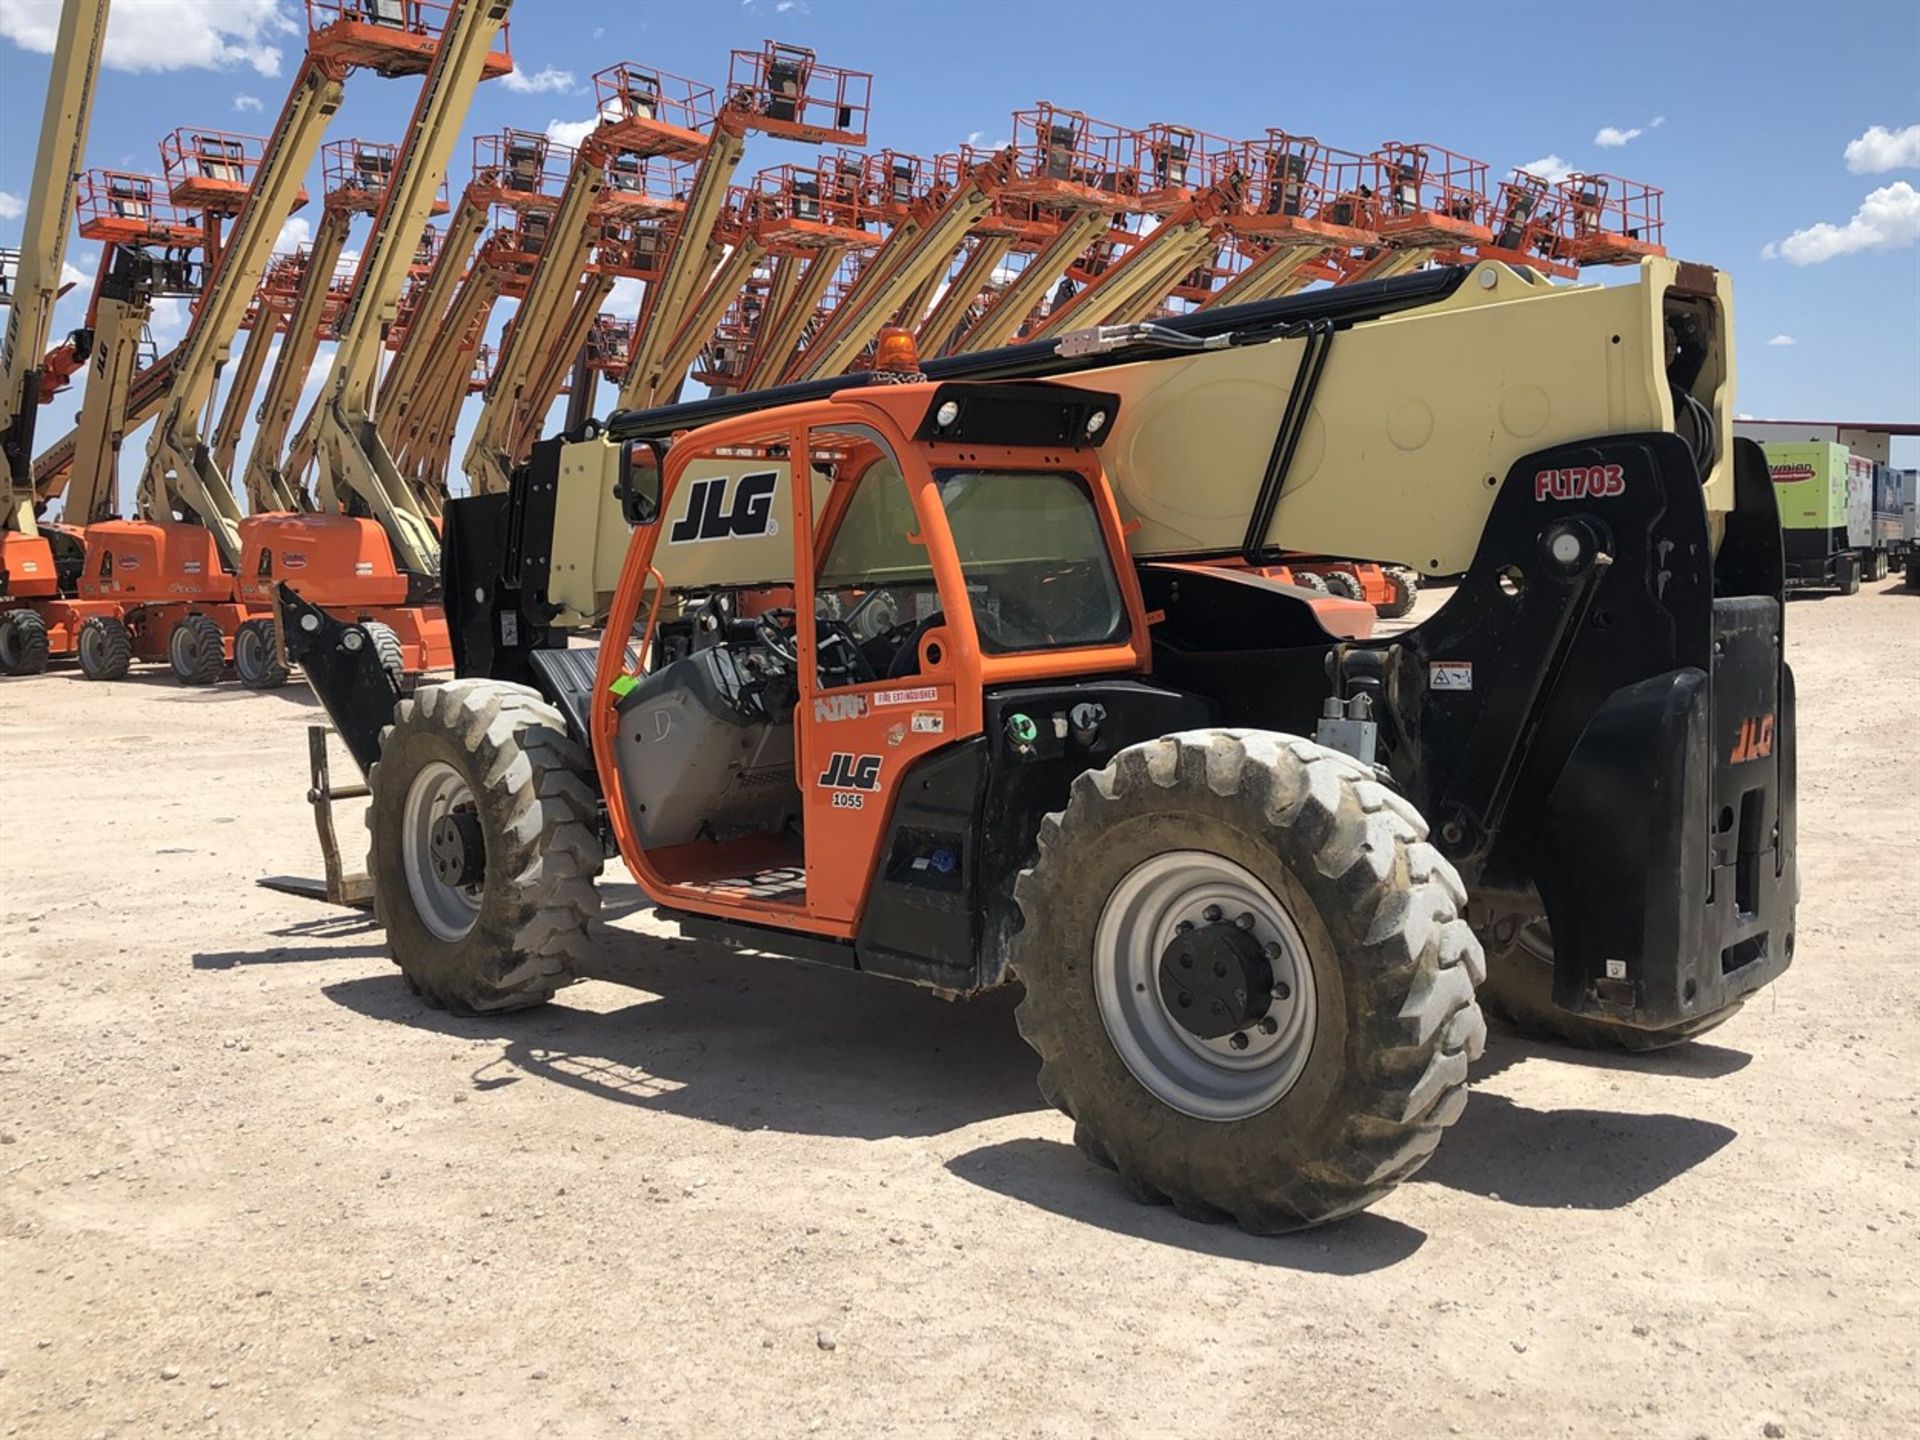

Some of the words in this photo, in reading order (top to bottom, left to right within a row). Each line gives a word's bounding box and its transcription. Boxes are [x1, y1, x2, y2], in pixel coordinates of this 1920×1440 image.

[96, 341, 109, 379] JLG
[1535, 464, 1625, 502] FL1703
[669, 470, 779, 545] JLG
[878, 694, 891, 704] FIRE
[893, 689, 935, 702] EXTINGUISHER
[1730, 713, 1773, 764] JLG
[819, 753, 883, 791] JLG
[832, 793, 863, 809] 1055
